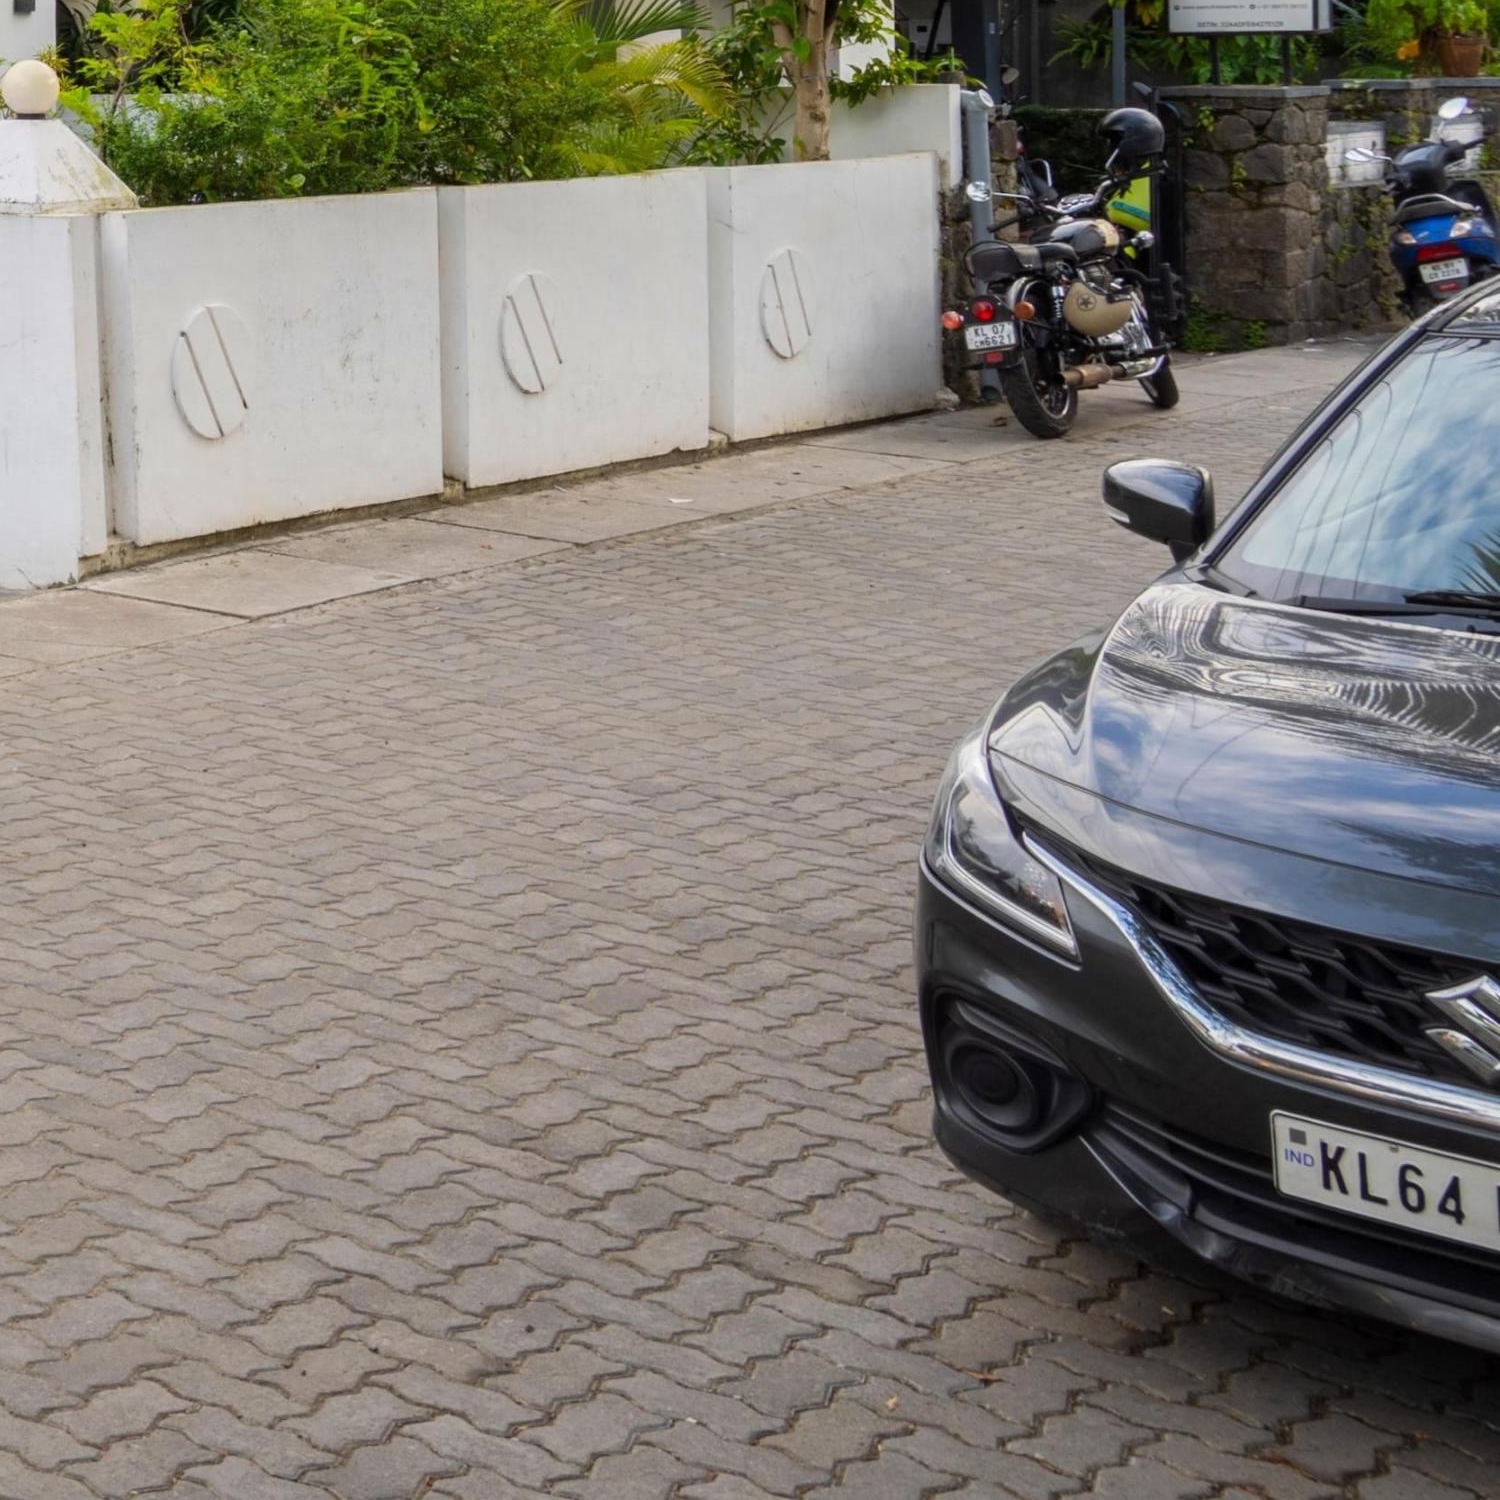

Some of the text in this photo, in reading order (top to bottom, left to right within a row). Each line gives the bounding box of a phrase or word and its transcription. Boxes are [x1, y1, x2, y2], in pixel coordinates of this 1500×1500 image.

[973, 324, 1006, 337] KL 07
[1284, 1147, 1316, 1168] IND
[1319, 1138, 1466, 1225] KL64
